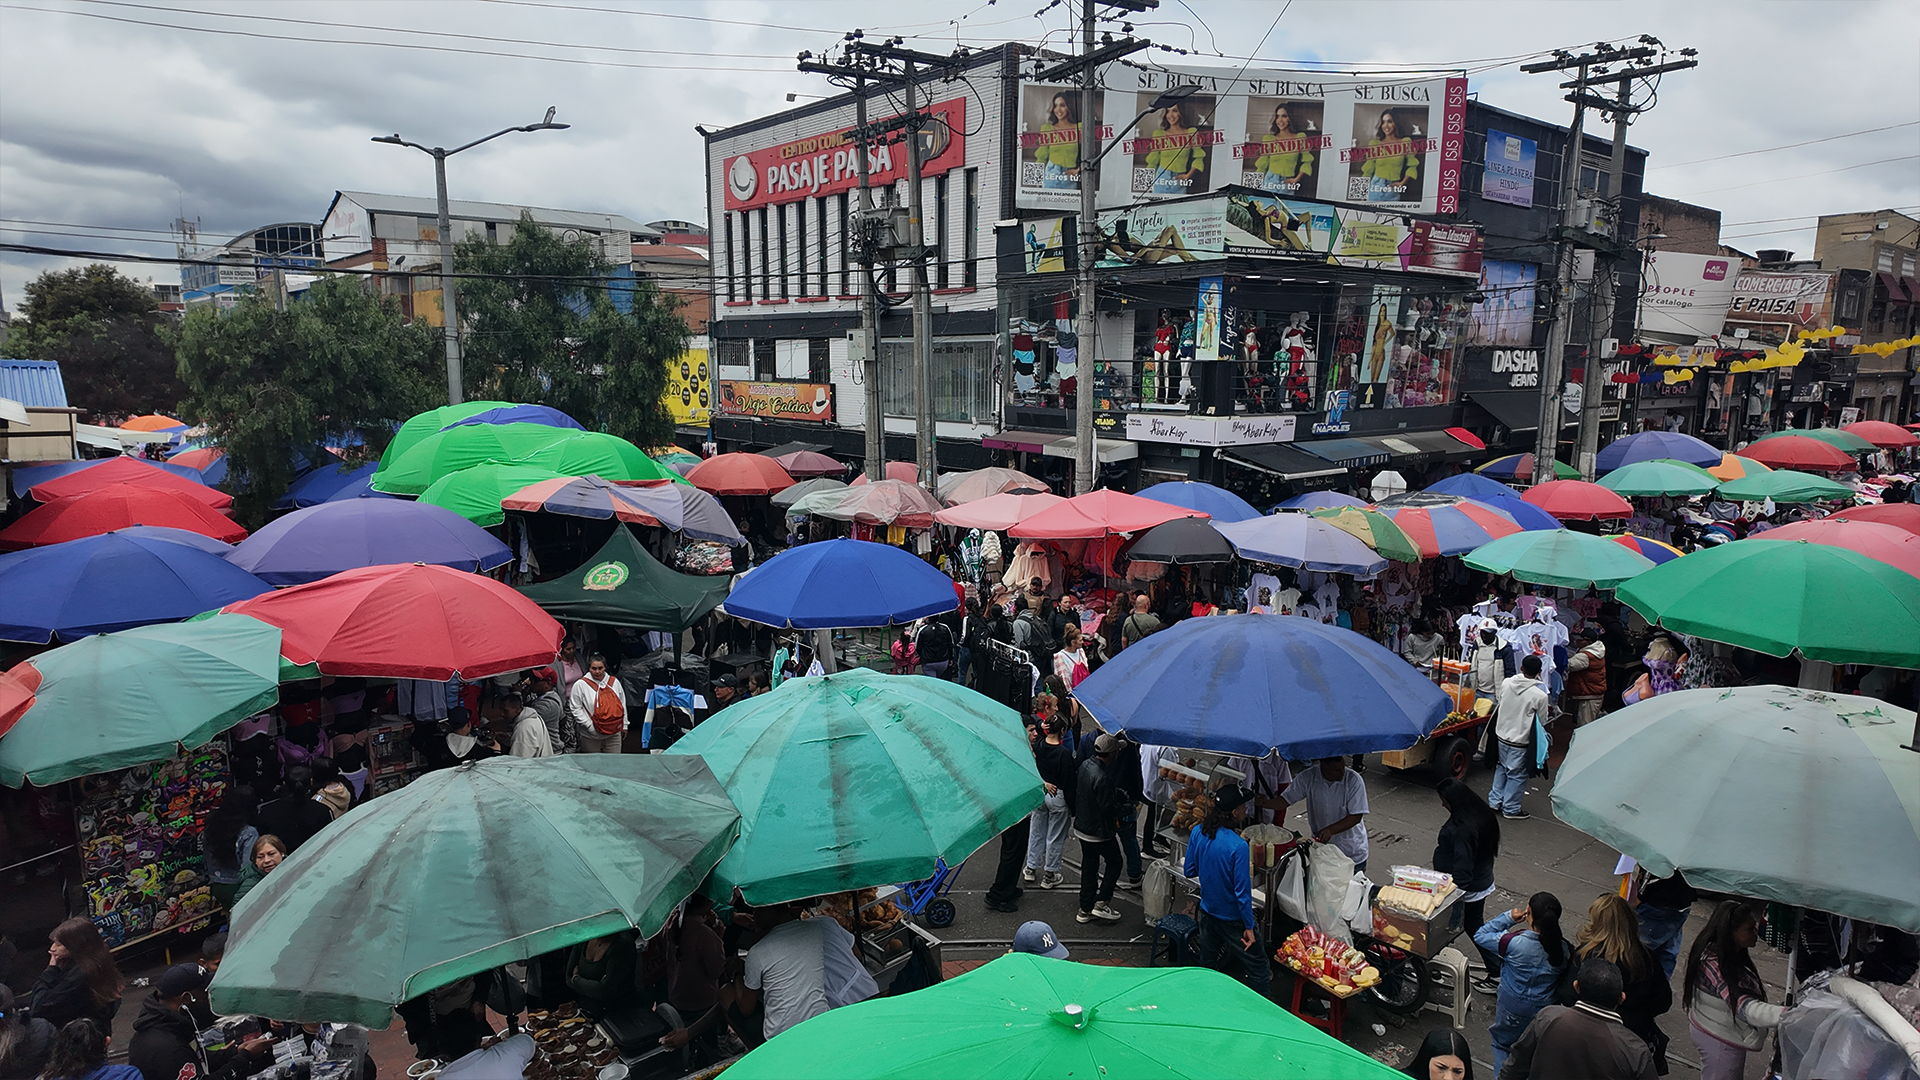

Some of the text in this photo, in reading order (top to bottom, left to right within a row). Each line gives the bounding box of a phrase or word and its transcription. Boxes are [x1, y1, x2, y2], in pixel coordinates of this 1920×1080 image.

[1138, 73, 1218, 92] SE BUSCA
[1249, 79, 1325, 98] SE BUSCA
[1354, 85, 1430, 102] SE BUSCA
[1449, 86, 1462, 107] ISIS
[1447, 112, 1461, 134] ISIS
[780, 139, 817, 160] CENTRO
[1123, 131, 1225, 154] EMPRENDEDOR
[1232, 136, 1333, 159] EMPRENDEDOR
[1339, 139, 1438, 163] EMPRENDEDOR
[1445, 140, 1459, 161] ISIS
[768, 144, 893, 194] PASAJE PASA
[1487, 161, 1533, 180] LINEA PLAYERA
[1155, 177, 1193, 187] ¿Eres tú?
[1263, 182, 1301, 191] ¿Eres tú?
[1370, 185, 1408, 193] ¿Eres tú?
[1442, 169, 1457, 190] ISIS
[1441, 195, 1454, 214] SIS
[1647, 284, 1696, 297] PEOPLE
[1655, 298, 1693, 308] catalogo
[1746, 297, 1797, 314] PAISA
[1492, 350, 1538, 373] DASHA
[1509, 373, 1538, 388] JEANS
[1661, 385, 1688, 395] LA ONCE
[769, 396, 812, 415] Caldas
[1316, 422, 1351, 433] NAPOLES
[1370, 453, 1389, 465] MODA
[1042, 932, 1054, 948] NY
